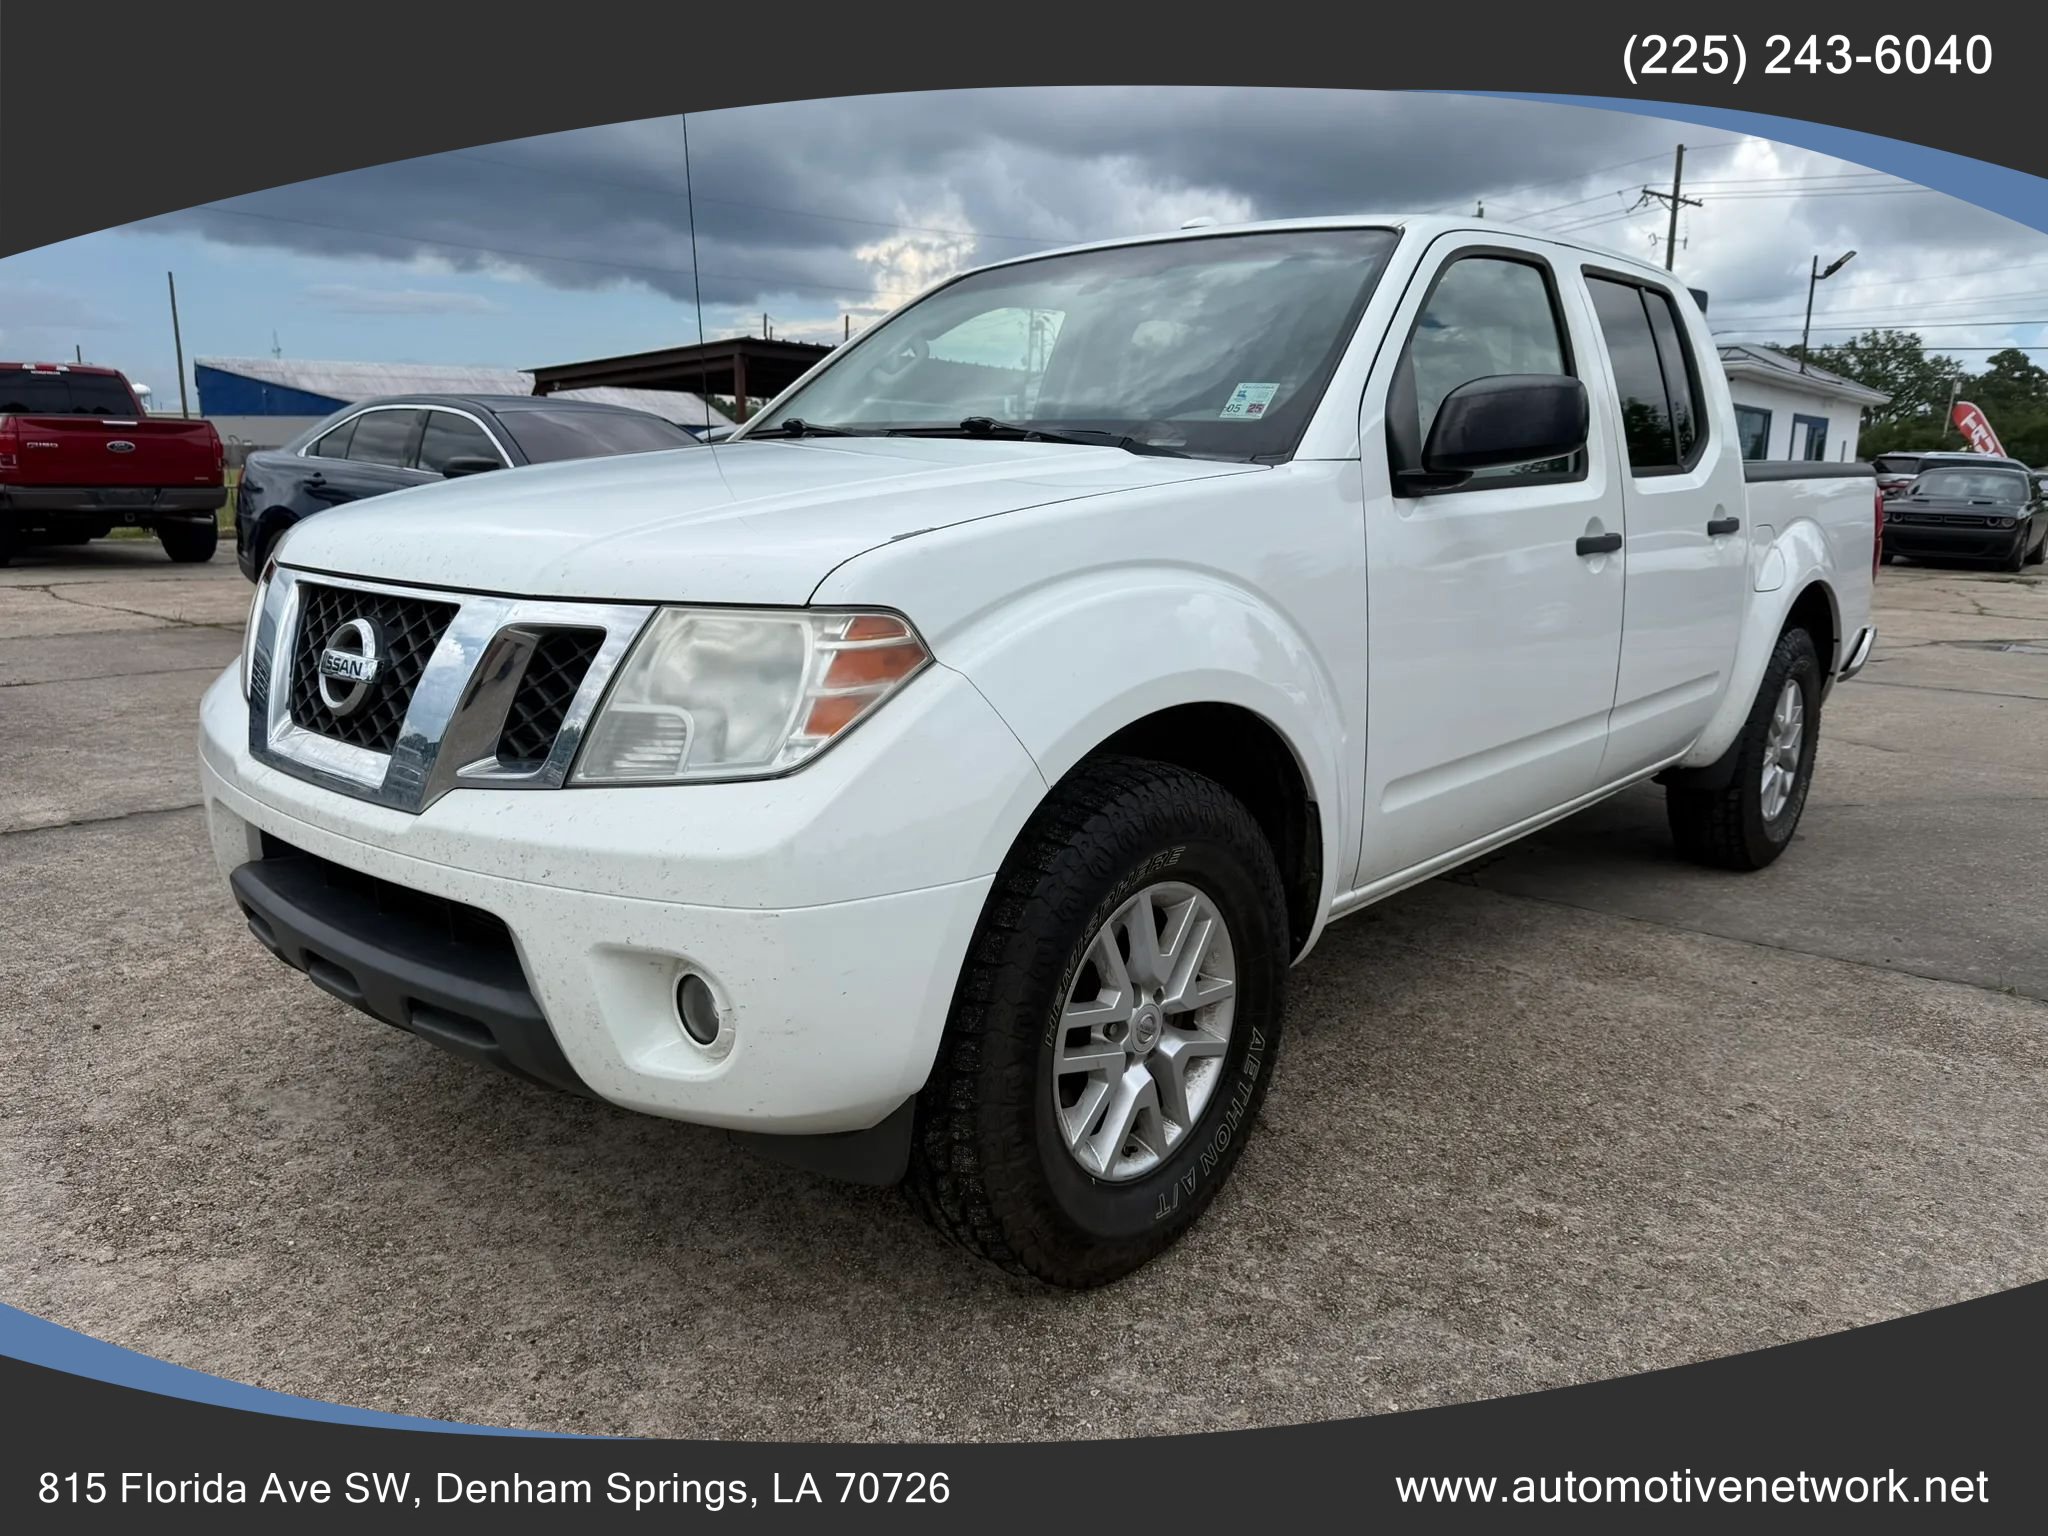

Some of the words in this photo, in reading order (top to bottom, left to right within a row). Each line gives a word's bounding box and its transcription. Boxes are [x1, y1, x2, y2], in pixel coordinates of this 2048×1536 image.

[1226, 403, 1241, 413] 05
[1247, 403, 1263, 413] 25
[1960, 411, 2000, 456] TRU
[1199, 1026, 1266, 1177] AETHON
[1155, 1166, 1196, 1220] A/T
